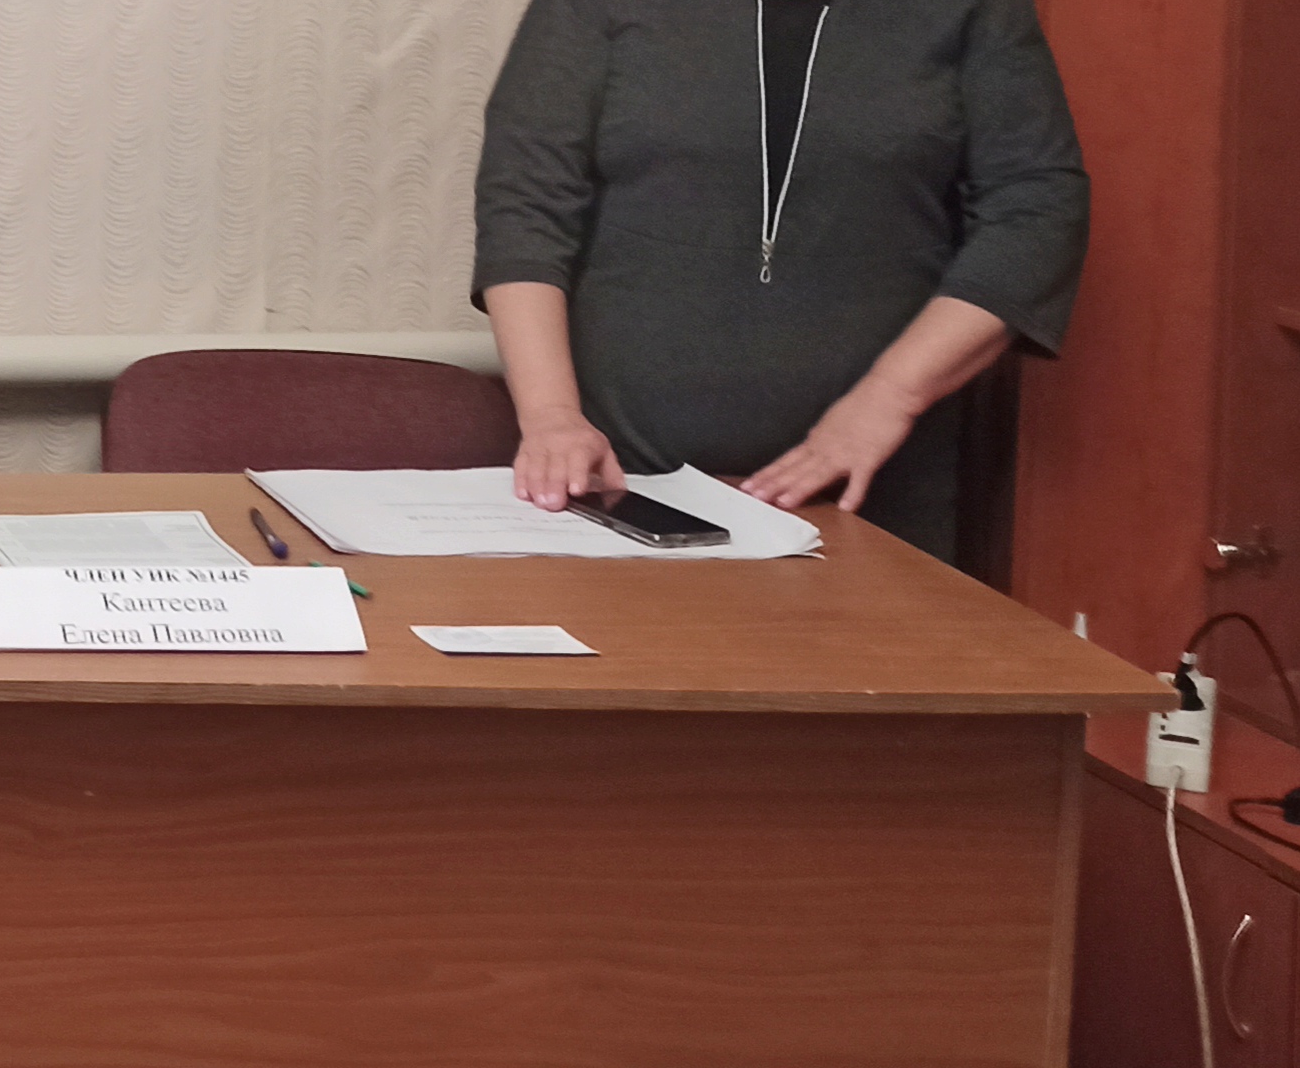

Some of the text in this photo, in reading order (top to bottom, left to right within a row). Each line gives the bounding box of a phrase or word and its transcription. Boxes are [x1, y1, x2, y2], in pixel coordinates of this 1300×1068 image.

[64, 567, 251, 583] ЧЛЕН УИК №1445
[100, 591, 228, 612] Кантеева
[59, 622, 286, 645] Елена Павловна
